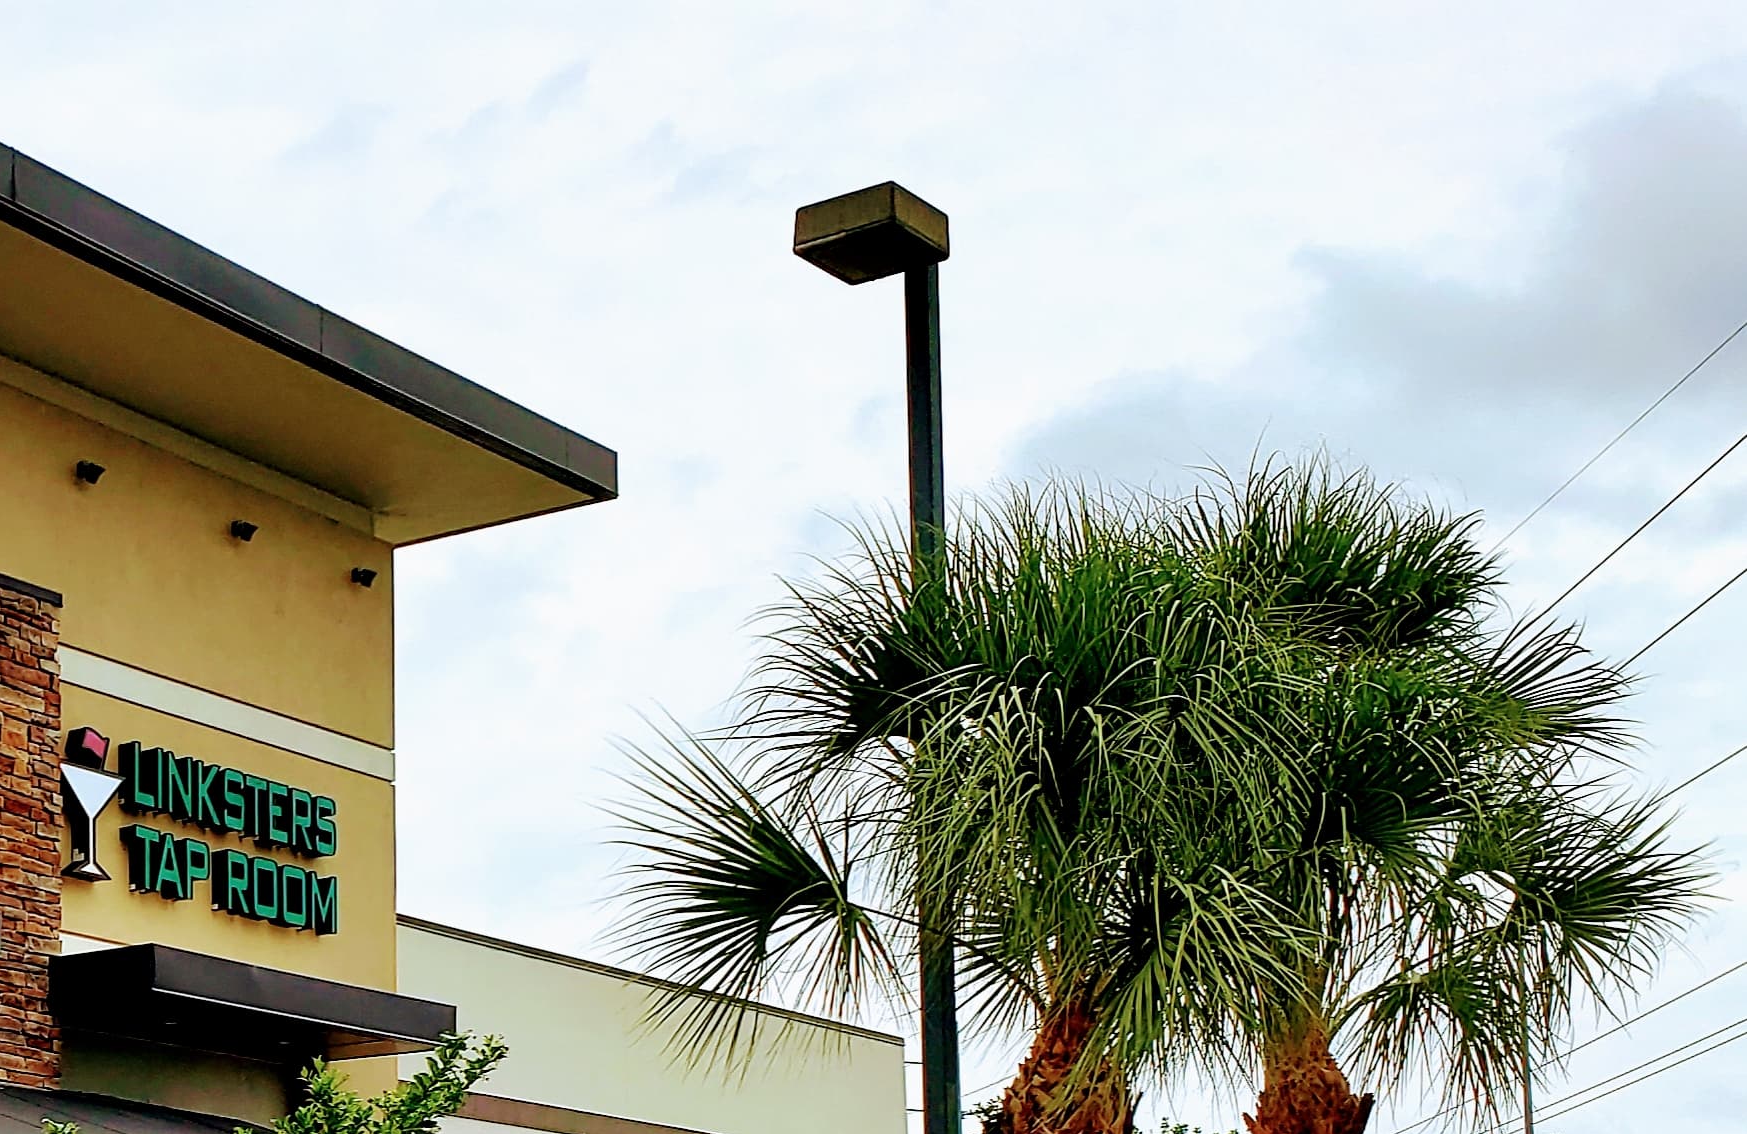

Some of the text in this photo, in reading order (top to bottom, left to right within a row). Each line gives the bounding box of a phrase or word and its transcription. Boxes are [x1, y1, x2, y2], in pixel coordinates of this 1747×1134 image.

[120, 741, 336, 858] LINKSTERS
[123, 824, 337, 934] TAP ROOM
